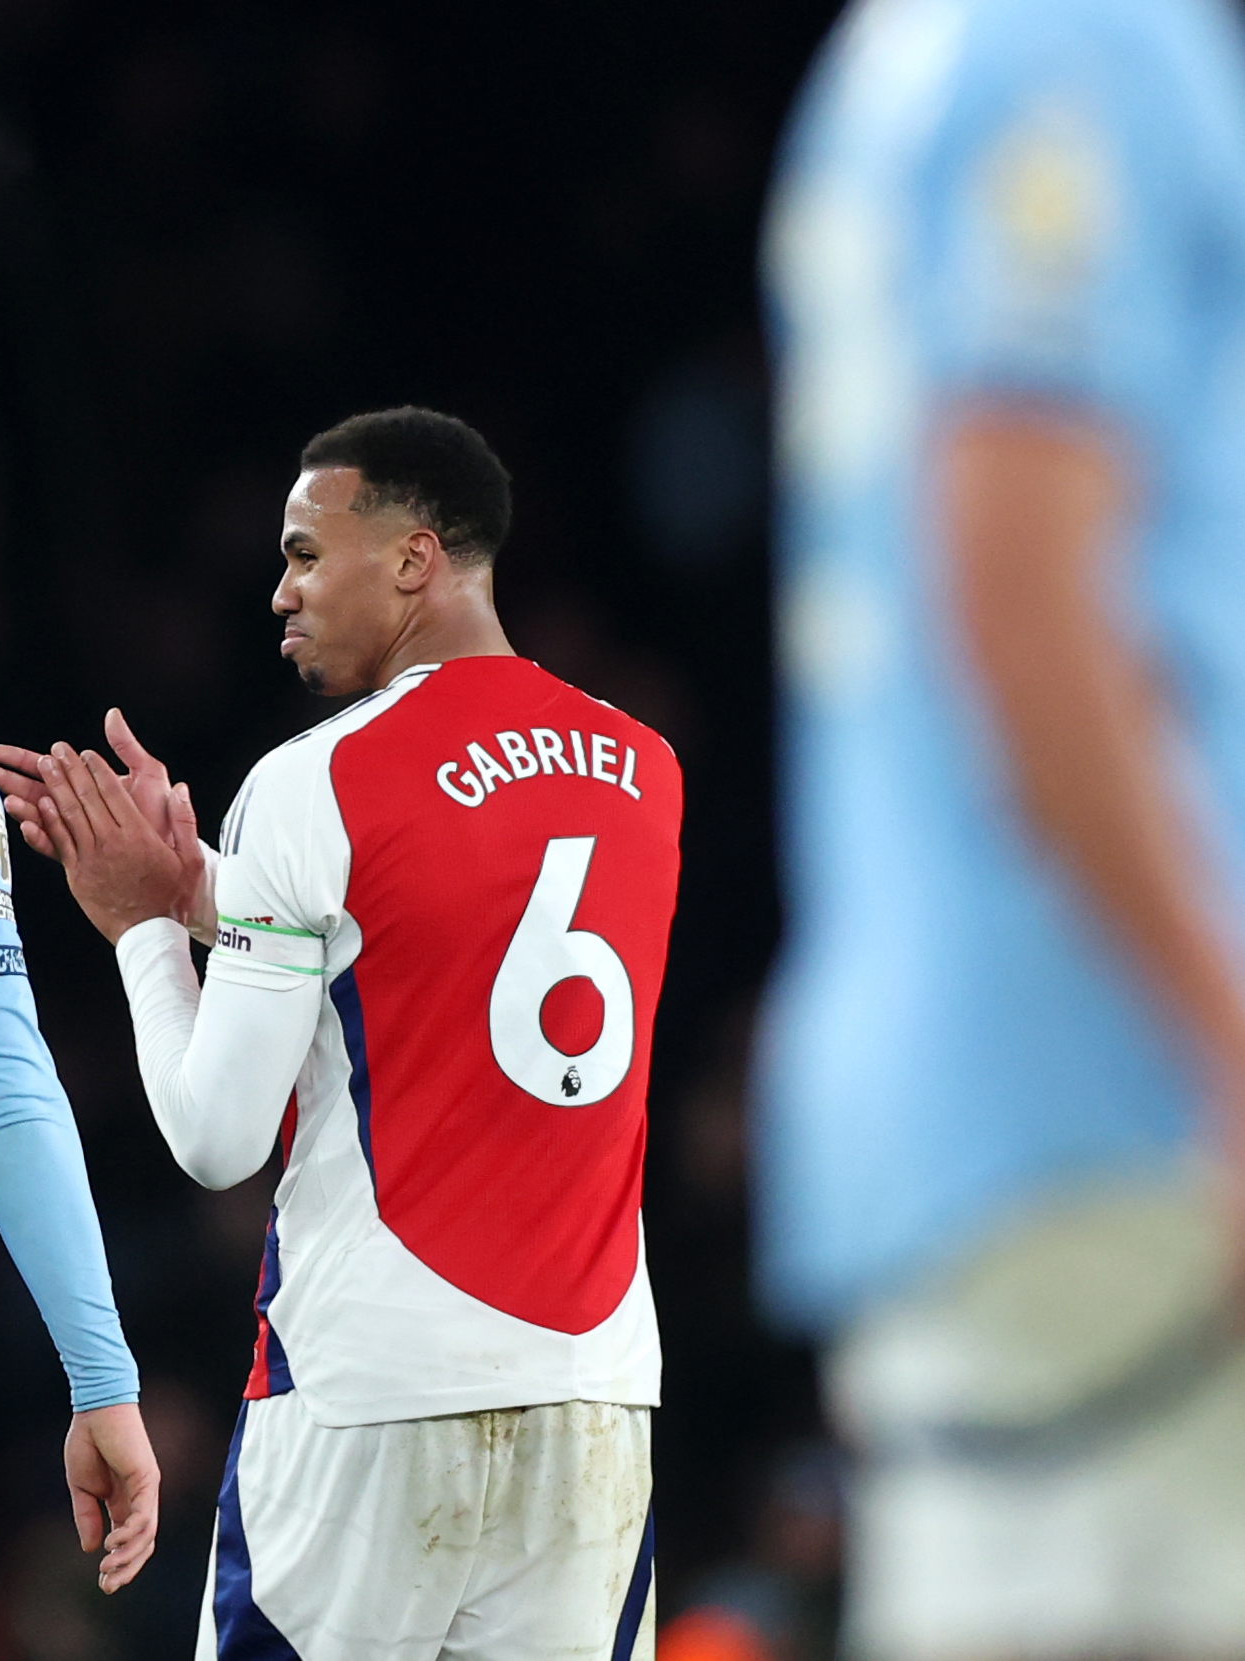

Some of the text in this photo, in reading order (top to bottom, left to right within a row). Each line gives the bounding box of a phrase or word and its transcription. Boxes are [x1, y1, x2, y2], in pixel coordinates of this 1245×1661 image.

[436, 727, 643, 808] GABRIEL
[217, 926, 252, 952] tain
[488, 834, 635, 1107] 6
